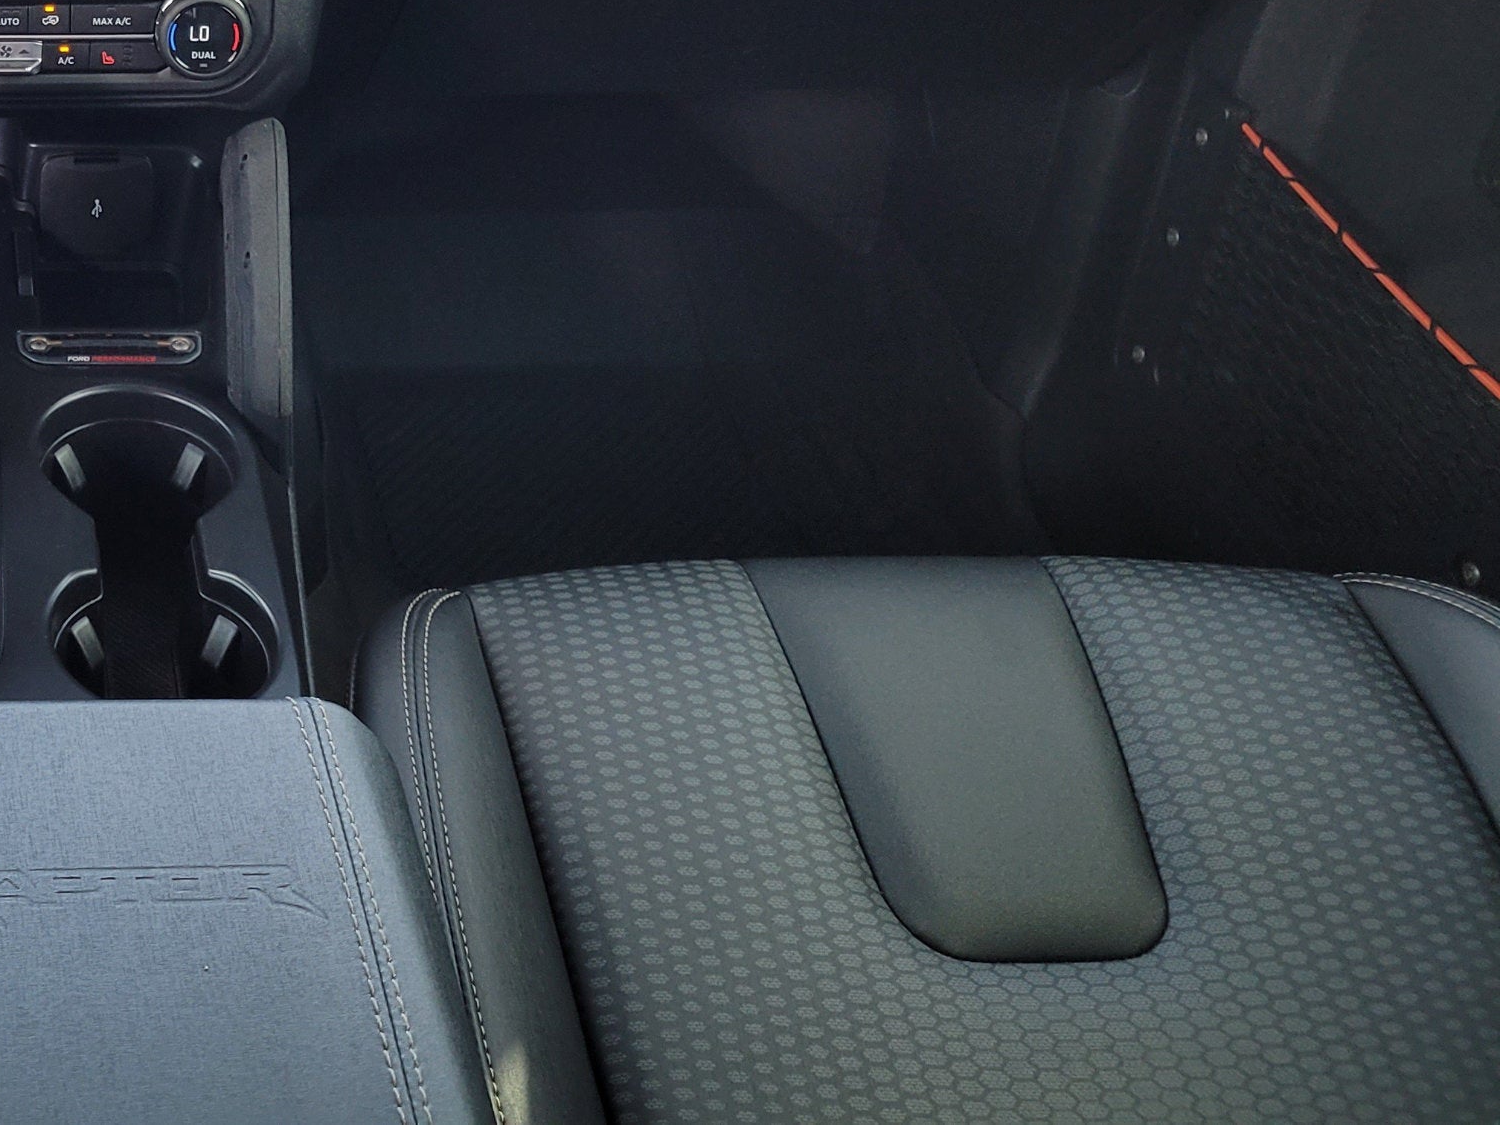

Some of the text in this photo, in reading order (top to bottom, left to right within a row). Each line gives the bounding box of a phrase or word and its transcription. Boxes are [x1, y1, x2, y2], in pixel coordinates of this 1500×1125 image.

[92, 16, 131, 25] MAX A/C
[191, 50, 216, 59] DUAL
[57, 56, 75, 65] A/C
